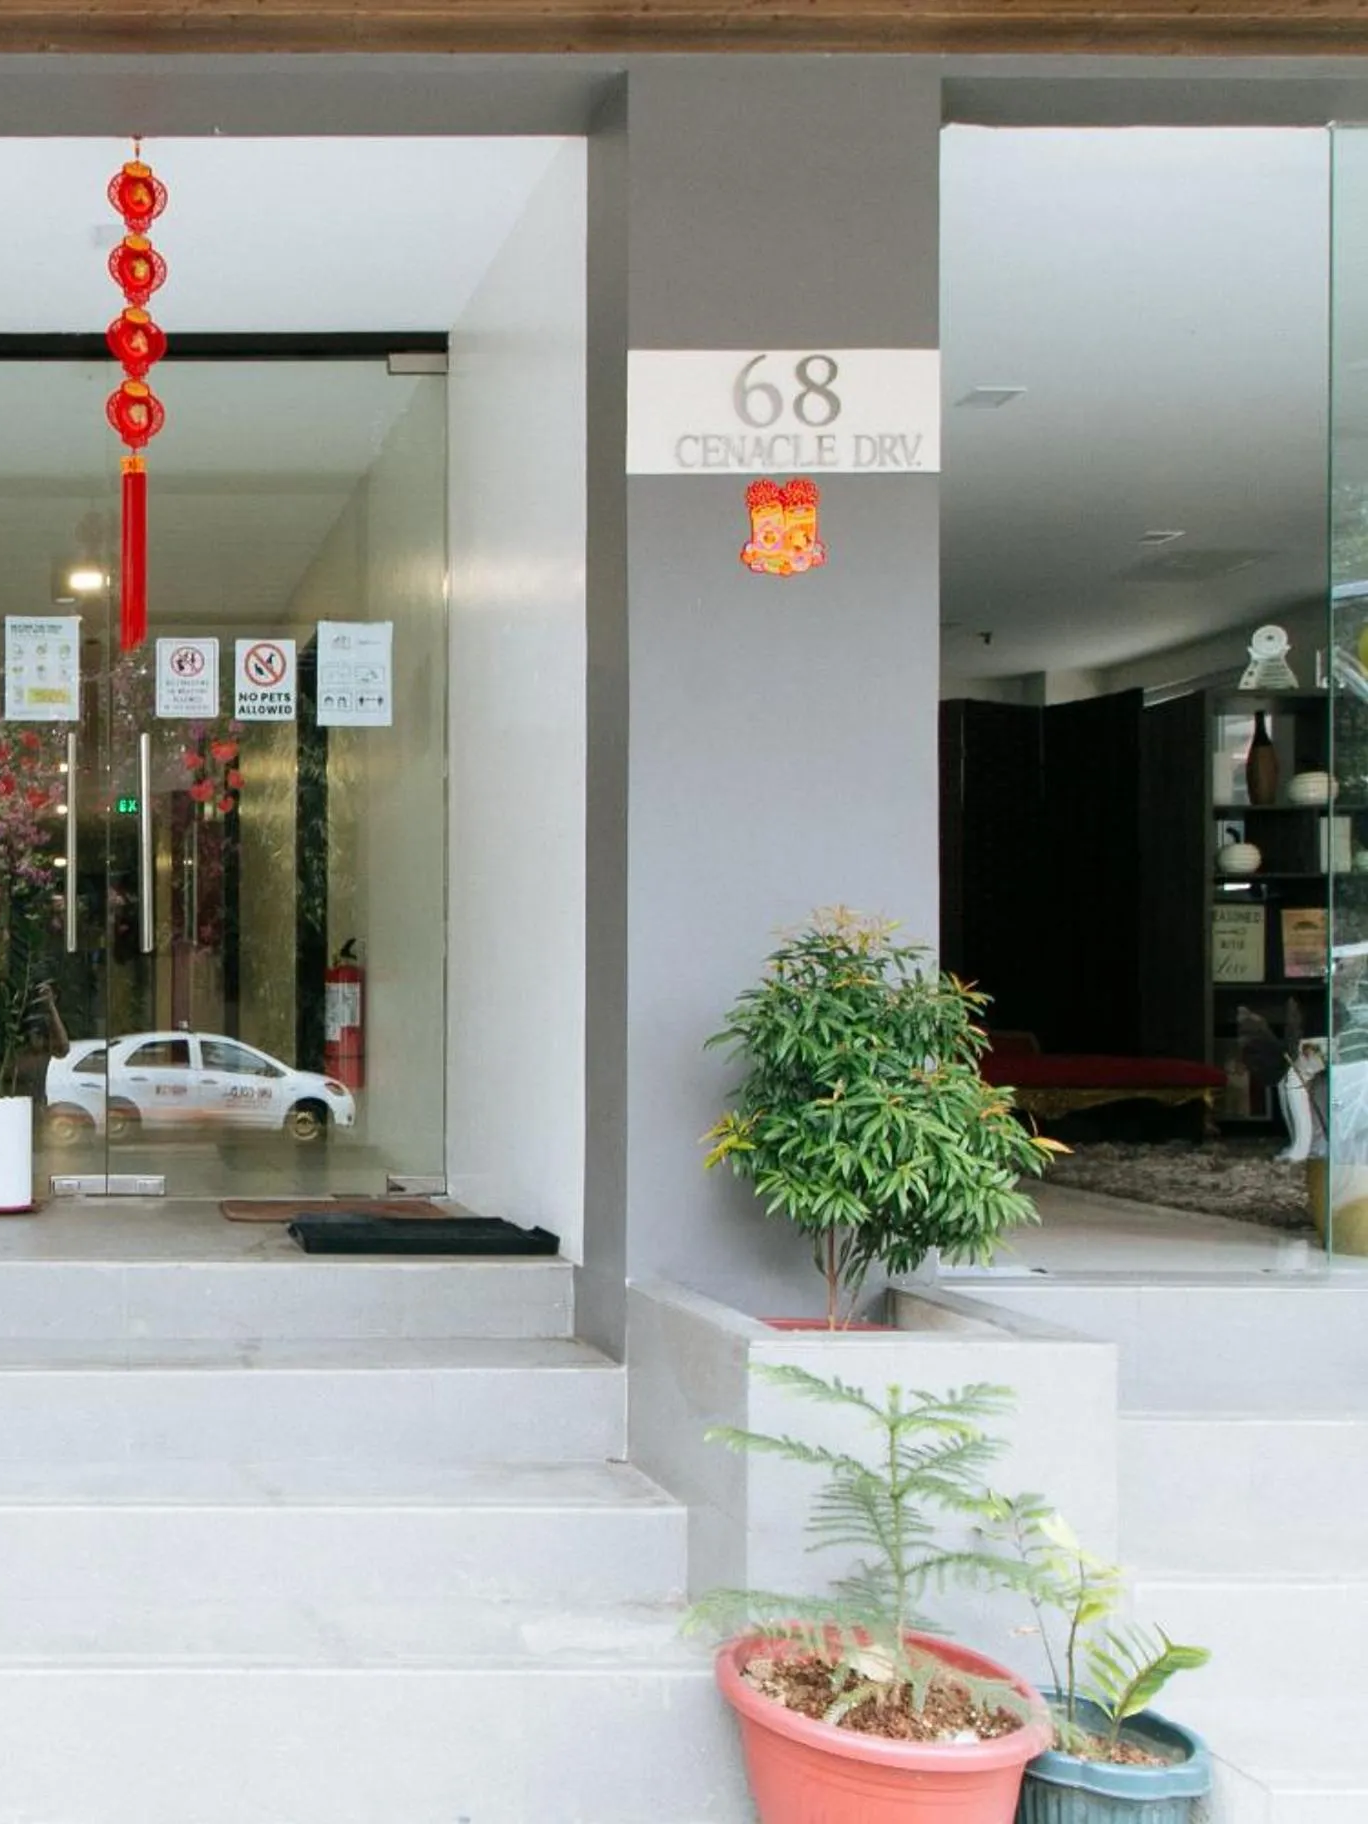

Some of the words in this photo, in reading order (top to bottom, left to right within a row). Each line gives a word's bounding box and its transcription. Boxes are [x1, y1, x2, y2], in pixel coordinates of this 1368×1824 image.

[733, 354, 841, 428] 68
[675, 433, 839, 468] CENACLE
[851, 433, 923, 468] DRV.
[238, 692, 258, 702] NO
[260, 692, 291, 702] PETS
[238, 704, 293, 714] ALLOWED
